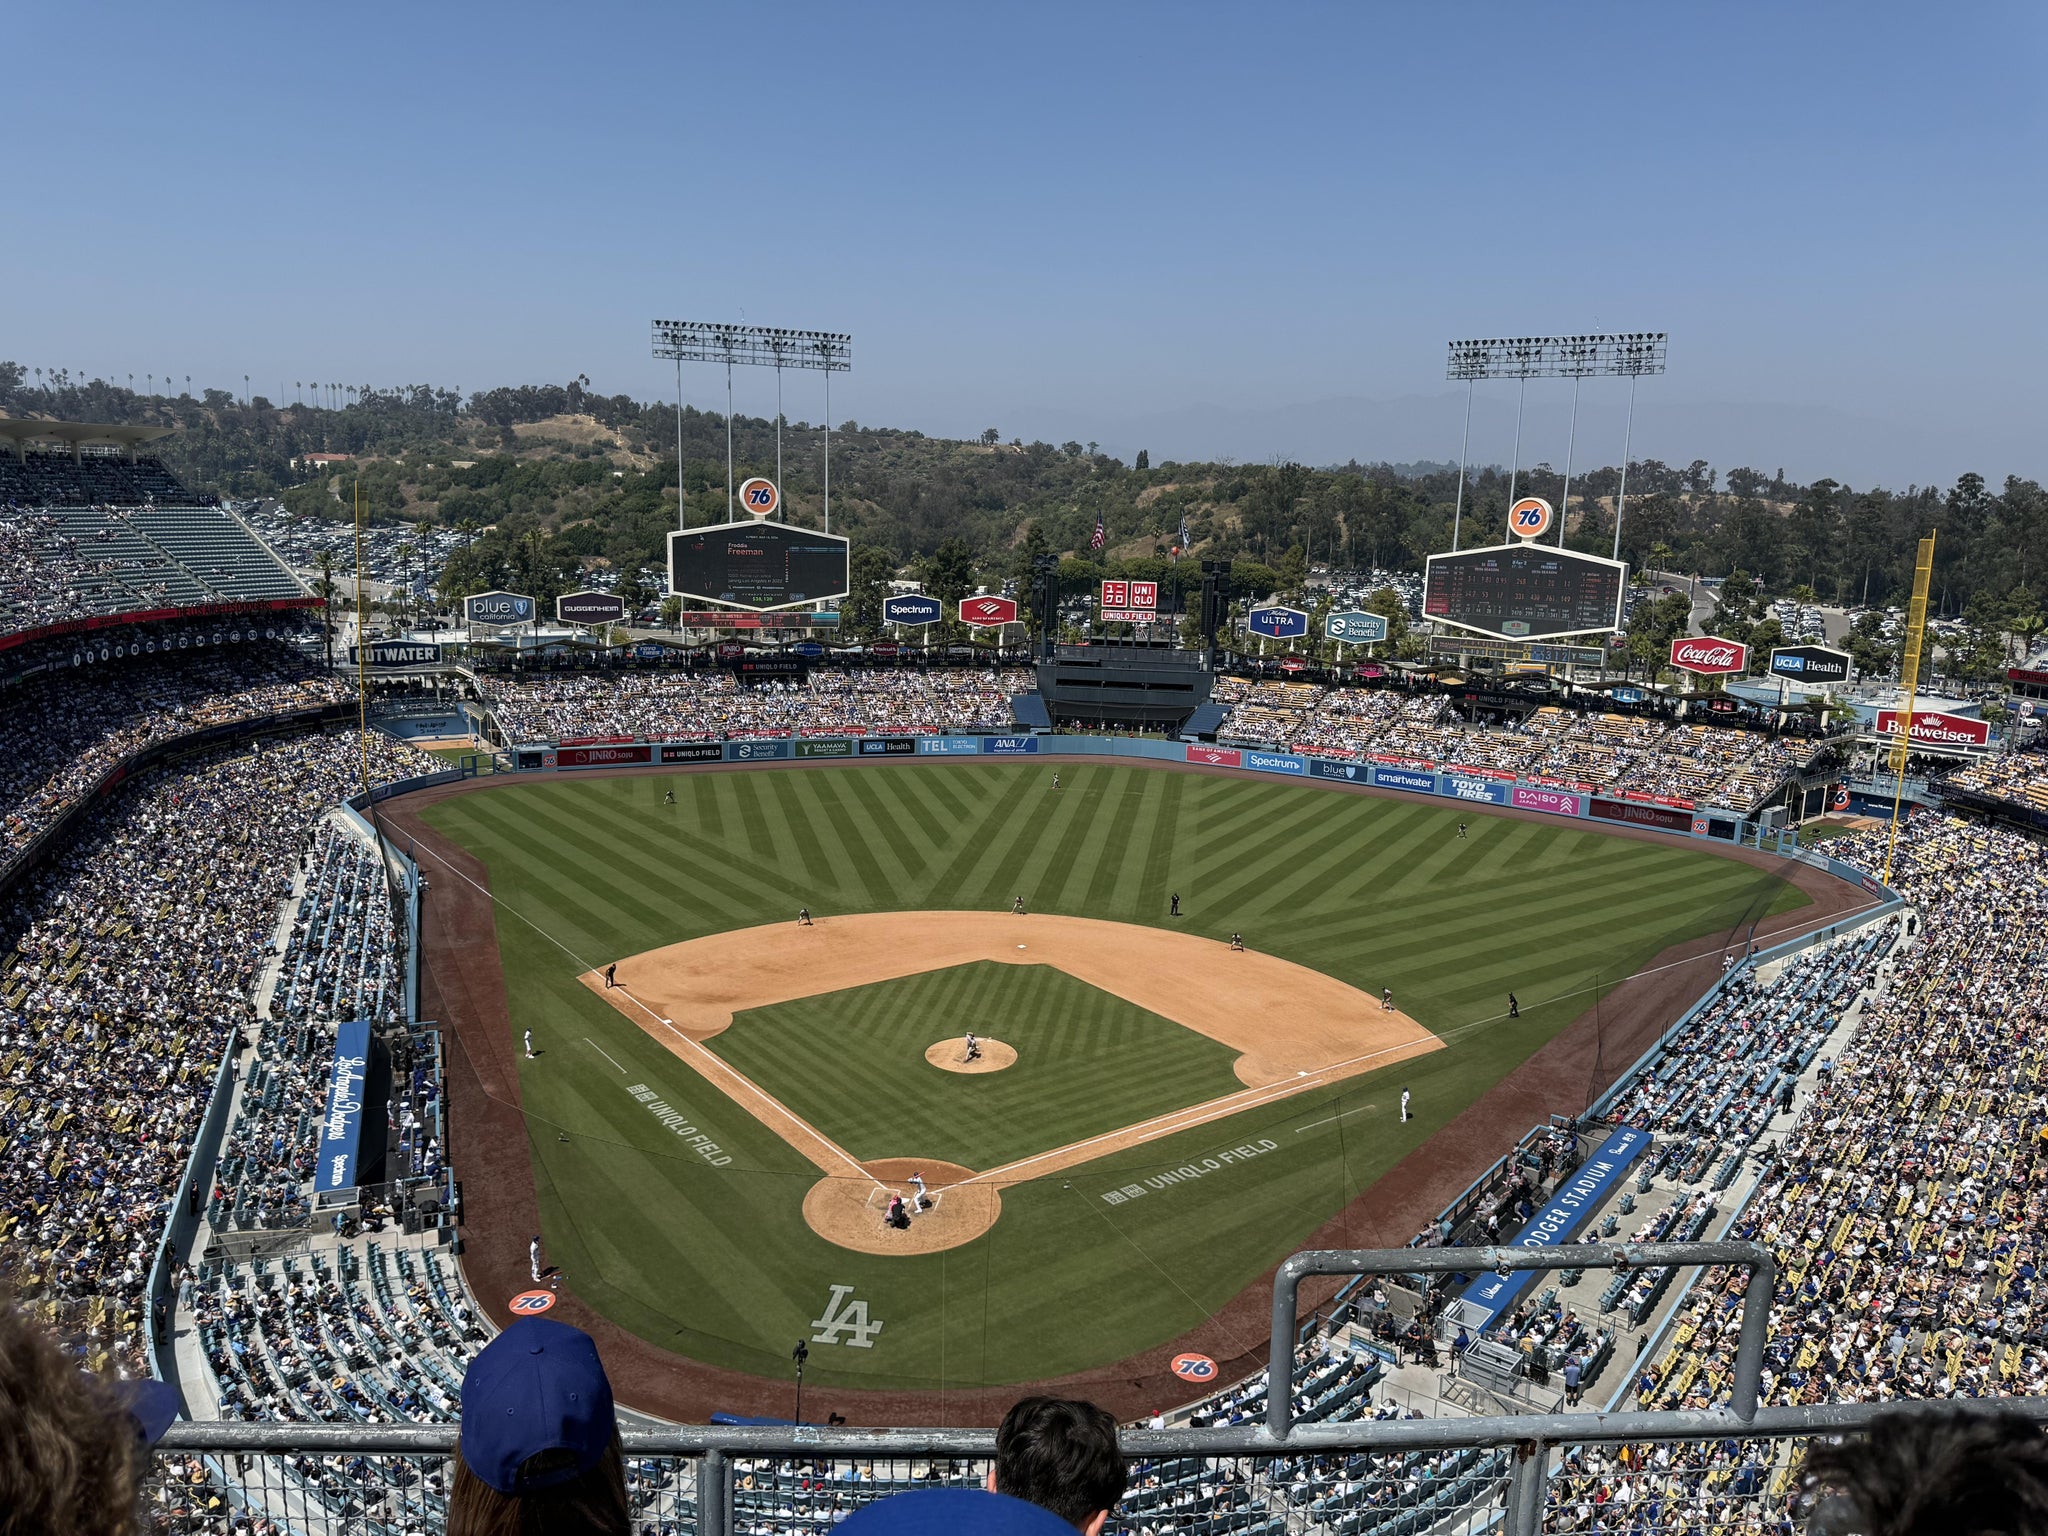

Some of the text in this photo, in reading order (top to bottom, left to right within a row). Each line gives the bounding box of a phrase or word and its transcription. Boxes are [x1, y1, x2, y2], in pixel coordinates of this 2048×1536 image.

[750, 488, 771, 505] 76
[1517, 508, 1541, 526] 76
[728, 548, 763, 556] Freeman
[1134, 586, 1151, 594] UNI
[473, 600, 510, 613] blue
[1134, 596, 1152, 605] QLO
[204, 603, 235, 616] ANGELES
[237, 600, 272, 614] DODGERS
[891, 604, 932, 615] Spectrum
[1104, 612, 1130, 620] UNIQLO
[1261, 616, 1294, 625] ULTRA
[1348, 619, 1381, 629] Security
[1348, 628, 1375, 637] Benefit
[1677, 643, 1737, 667] Coca-Cola
[1775, 658, 1842, 674] UCLA Health
[1479, 695, 1503, 704] UNIQLO
[1616, 689, 1636, 699] TEL
[1886, 719, 1975, 743] Budweiser
[753, 743, 777, 751] Security
[922, 740, 948, 751] TEL
[994, 740, 1016, 748] ANA
[545, 757, 555, 765] 76
[589, 749, 617, 763] JINRO
[1250, 754, 1296, 769] Spectrum
[1323, 764, 1345, 774] blue
[1378, 772, 1432, 788] smartwater
[1452, 779, 1486, 790] TOYO
[1456, 788, 1493, 801] TIRES
[1519, 790, 1558, 804] DAISO
[1623, 804, 1655, 821] JINRO
[1693, 822, 1706, 831] 76
[330, 1071, 364, 1103] Angeles
[324, 1102, 361, 1140] Dodgers
[647, 1101, 733, 1166] UNIQLO FIELD
[331, 1154, 349, 1181] Spectrum
[1144, 1139, 1278, 1189] UNIQLO FIELD
[1561, 1161, 1615, 1207] STADIUM
[515, 1294, 550, 1310] 76
[810, 1284, 884, 1348] LA
[1177, 1358, 1213, 1377] 76
